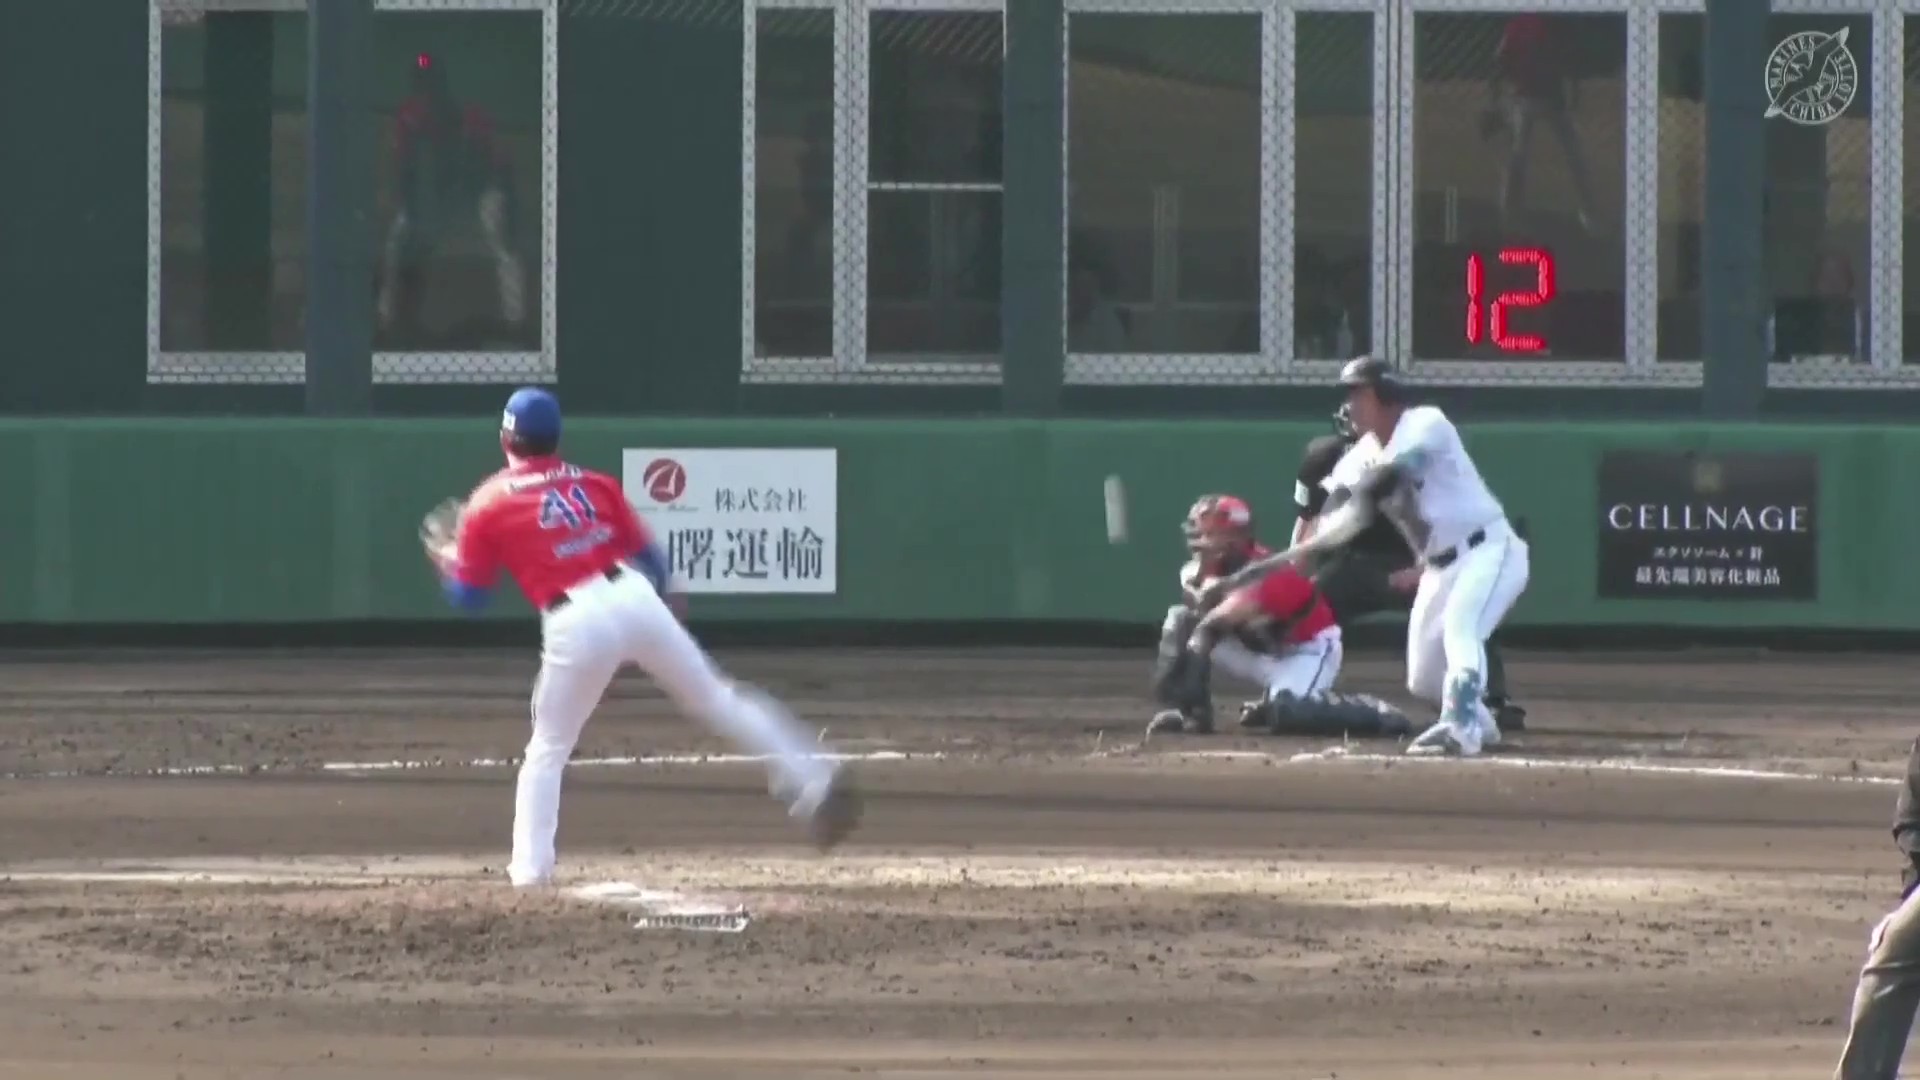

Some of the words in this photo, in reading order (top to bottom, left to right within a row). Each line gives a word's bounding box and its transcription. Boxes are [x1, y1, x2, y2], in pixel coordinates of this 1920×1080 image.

[1466, 248, 1555, 351] 12
[537, 483, 597, 530] 41
[714, 486, 808, 513] 株式会社
[1608, 502, 1808, 532] CELLNAGE
[668, 524, 825, 581] 曙運輸
[1635, 566, 1781, 586] 最先端美容化粧品
